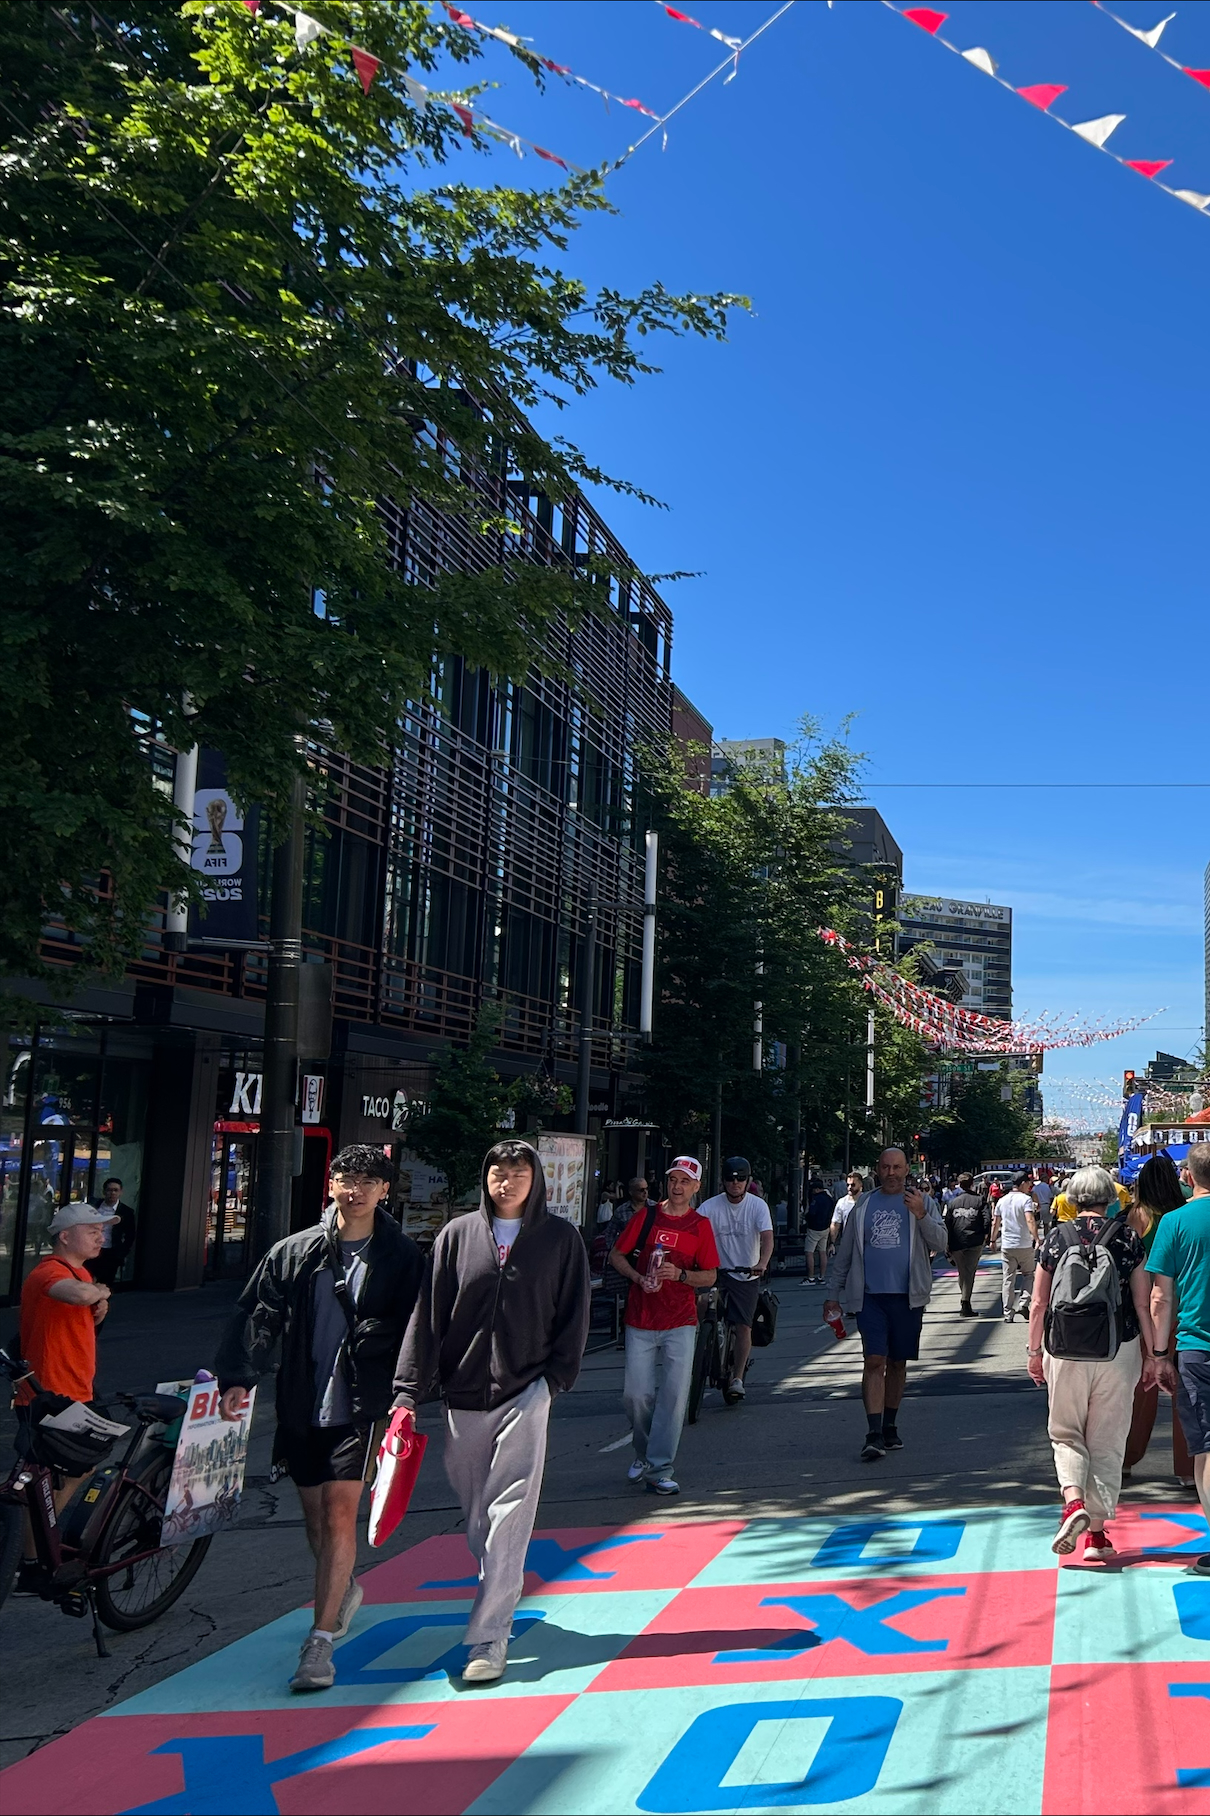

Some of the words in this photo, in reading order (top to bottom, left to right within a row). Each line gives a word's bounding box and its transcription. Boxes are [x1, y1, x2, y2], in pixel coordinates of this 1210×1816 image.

[948, 901, 1004, 920] GRANVILLE
[940, 1064, 962, 1072] elson
[58, 1097, 72, 1109] 956
[362, 1095, 391, 1118] TACO
[589, 1101, 609, 1112] oodle
